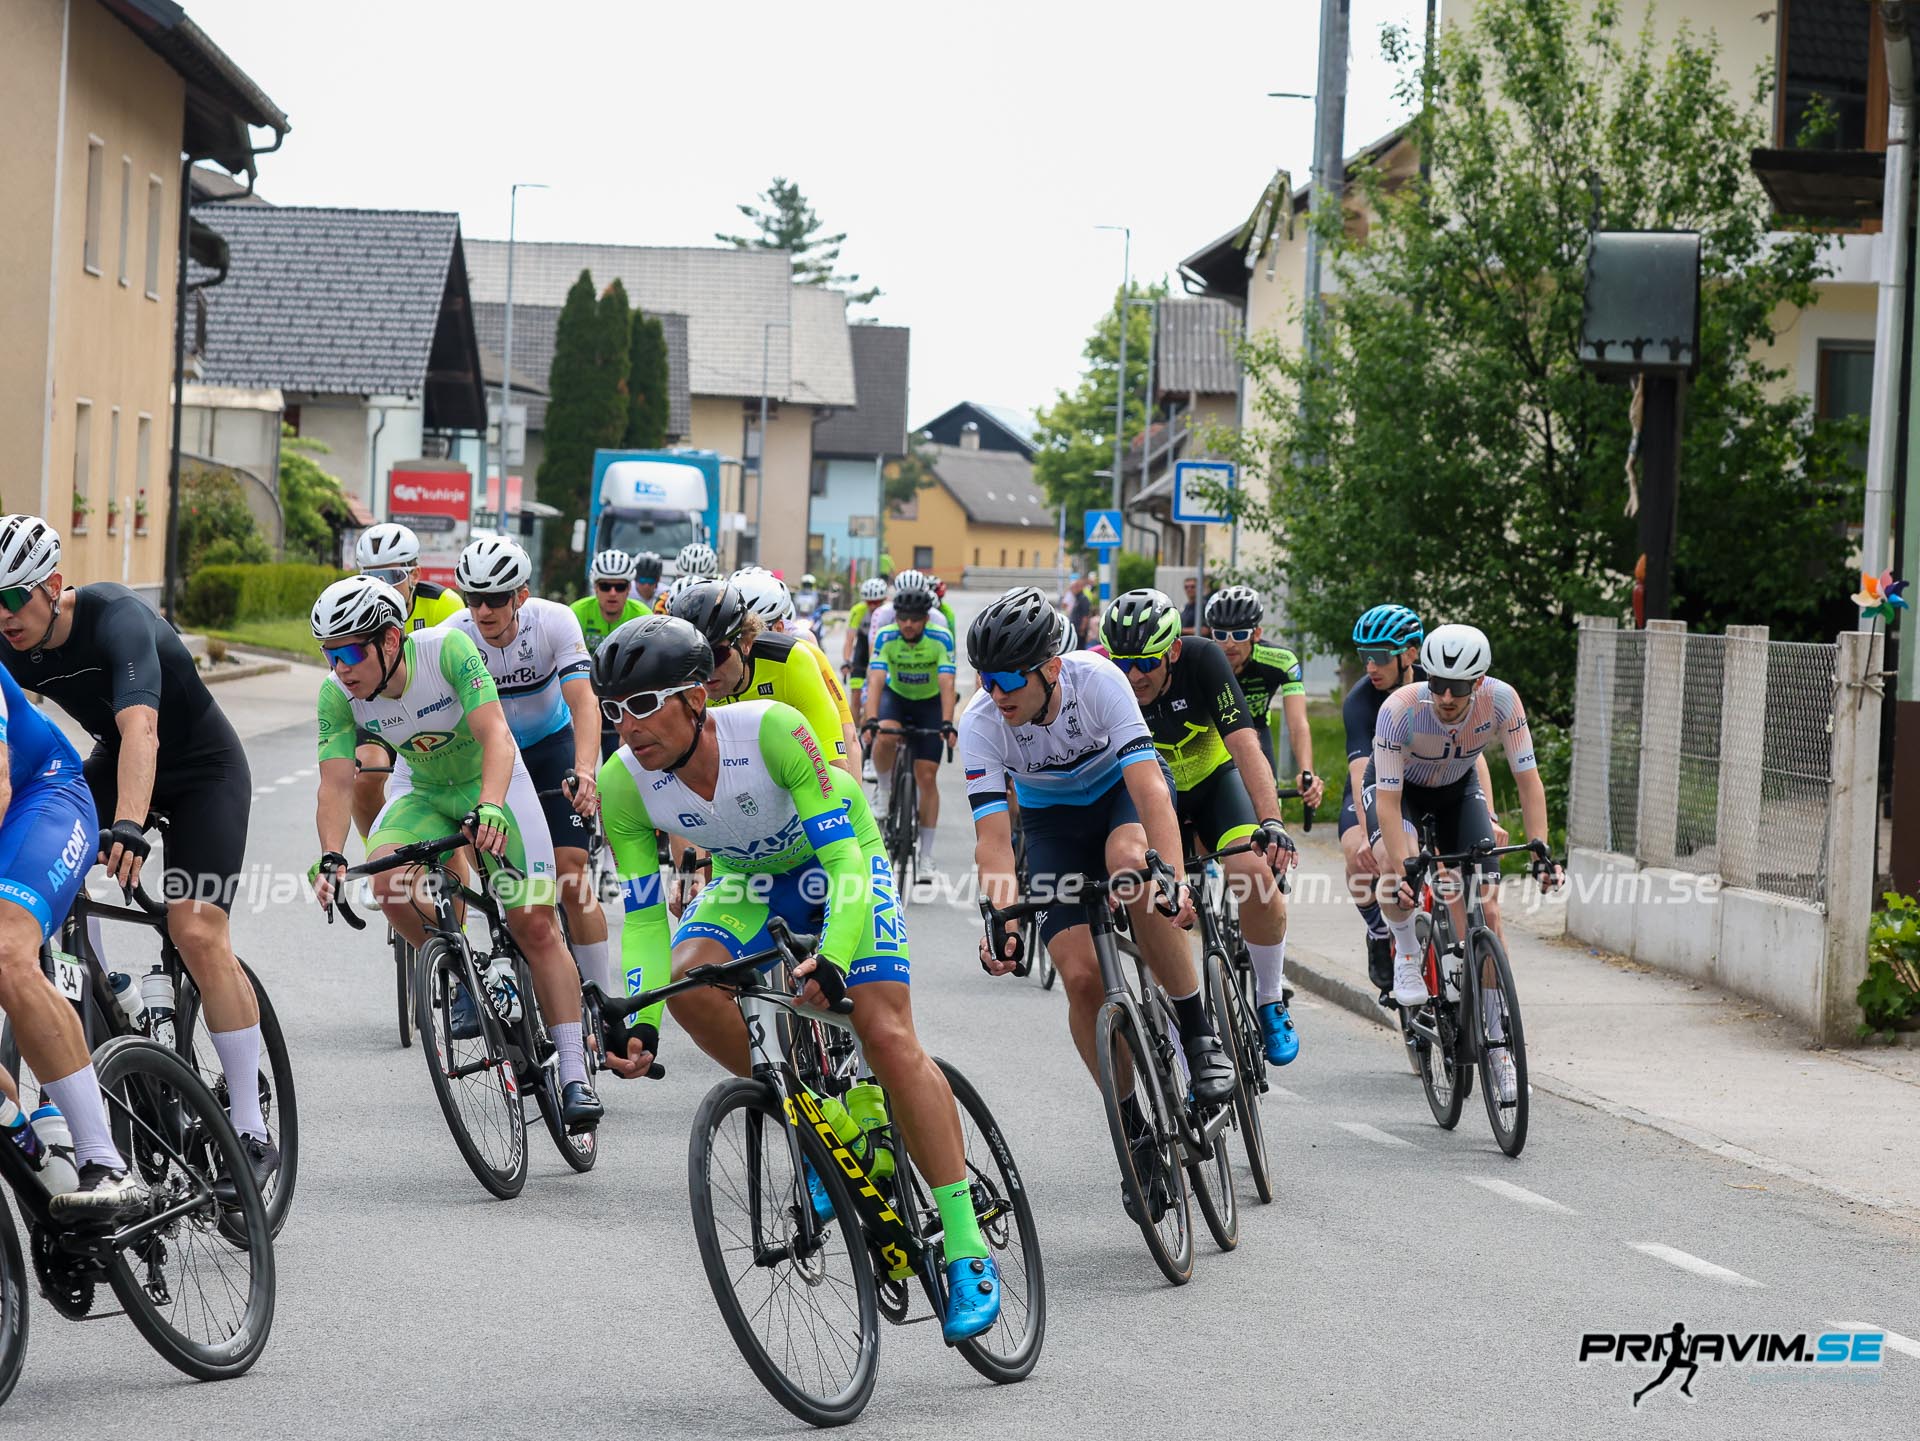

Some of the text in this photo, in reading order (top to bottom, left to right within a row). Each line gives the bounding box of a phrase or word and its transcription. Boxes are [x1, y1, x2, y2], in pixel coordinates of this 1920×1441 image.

[494, 666, 543, 686] amBi
[417, 692, 453, 719] geoplin
[381, 716, 404, 727] SAVA
[722, 757, 749, 767] IZVIR
[652, 772, 676, 791] IZVIR
[817, 815, 850, 832] IZVI
[47, 818, 87, 893] ARCONT
[871, 855, 898, 952] IZVIR
[687, 926, 729, 939] IZVIR
[60, 964, 77, 994] 34
[798, 1092, 904, 1226] SCOTT
[983, 1207, 999, 1221] SCOTT
